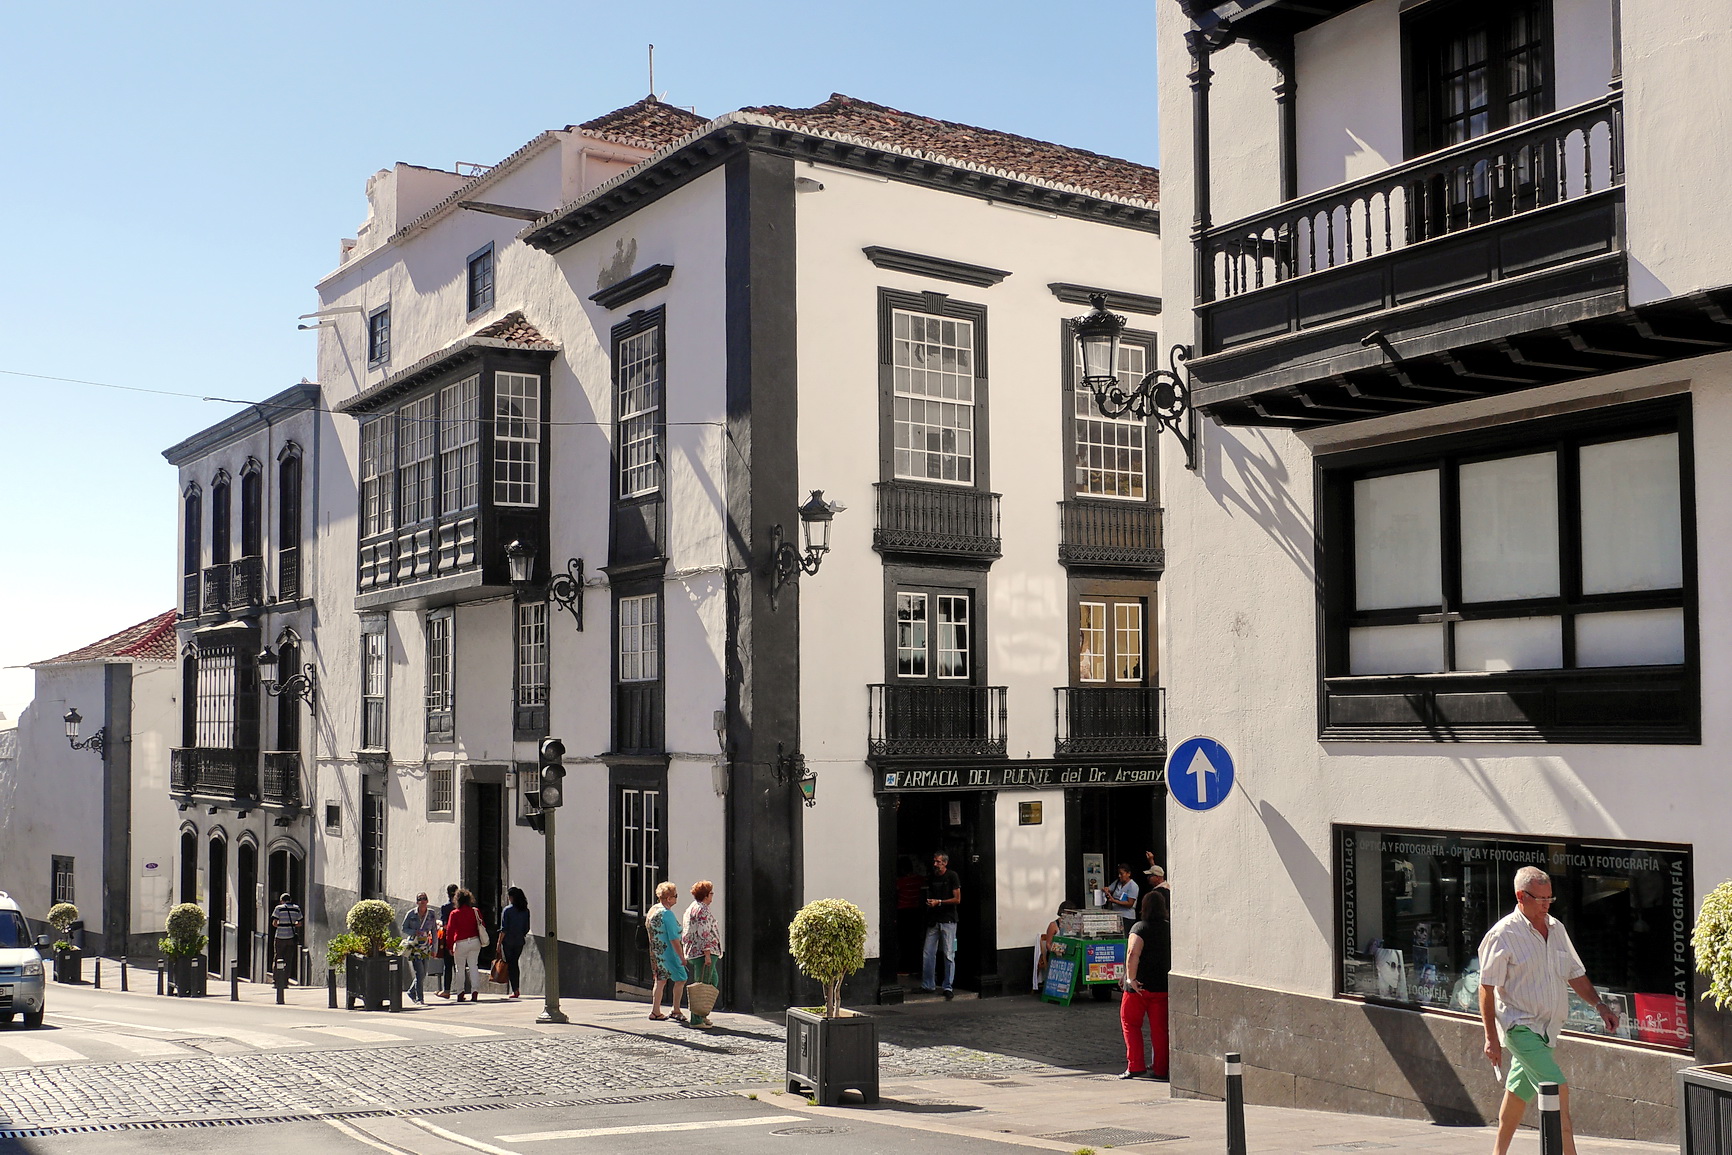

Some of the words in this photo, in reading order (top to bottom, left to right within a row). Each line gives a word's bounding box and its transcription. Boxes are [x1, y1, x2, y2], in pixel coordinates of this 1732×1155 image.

[895, 770, 959, 787] FARMACIA
[968, 769, 993, 785] DEL
[1002, 768, 1053, 784] PUENTE
[1060, 767, 1083, 783] del
[1088, 767, 1106, 782] Dr.
[1114, 766, 1164, 782] Argany
[1345, 838, 1355, 886] ÓPTICA
[1359, 839, 1388, 852] ÓPTICA
[1387, 841, 1394, 852] Y
[1394, 842, 1445, 857] FOTOGRAFÍA
[1450, 844, 1481, 859] ÓPTICA
[1482, 848, 1490, 859] Y
[1489, 849, 1546, 864] FOTOGRAFÍA
[1552, 851, 1587, 867] ÓPTICA
[1588, 855, 1595, 867] Y
[1596, 855, 1660, 872] FOTOGRAFÍA
[1345, 889, 1354, 898] Y
[1670, 860, 1685, 963] FOTOGRAFÍA
[1674, 967, 1686, 977] Y
